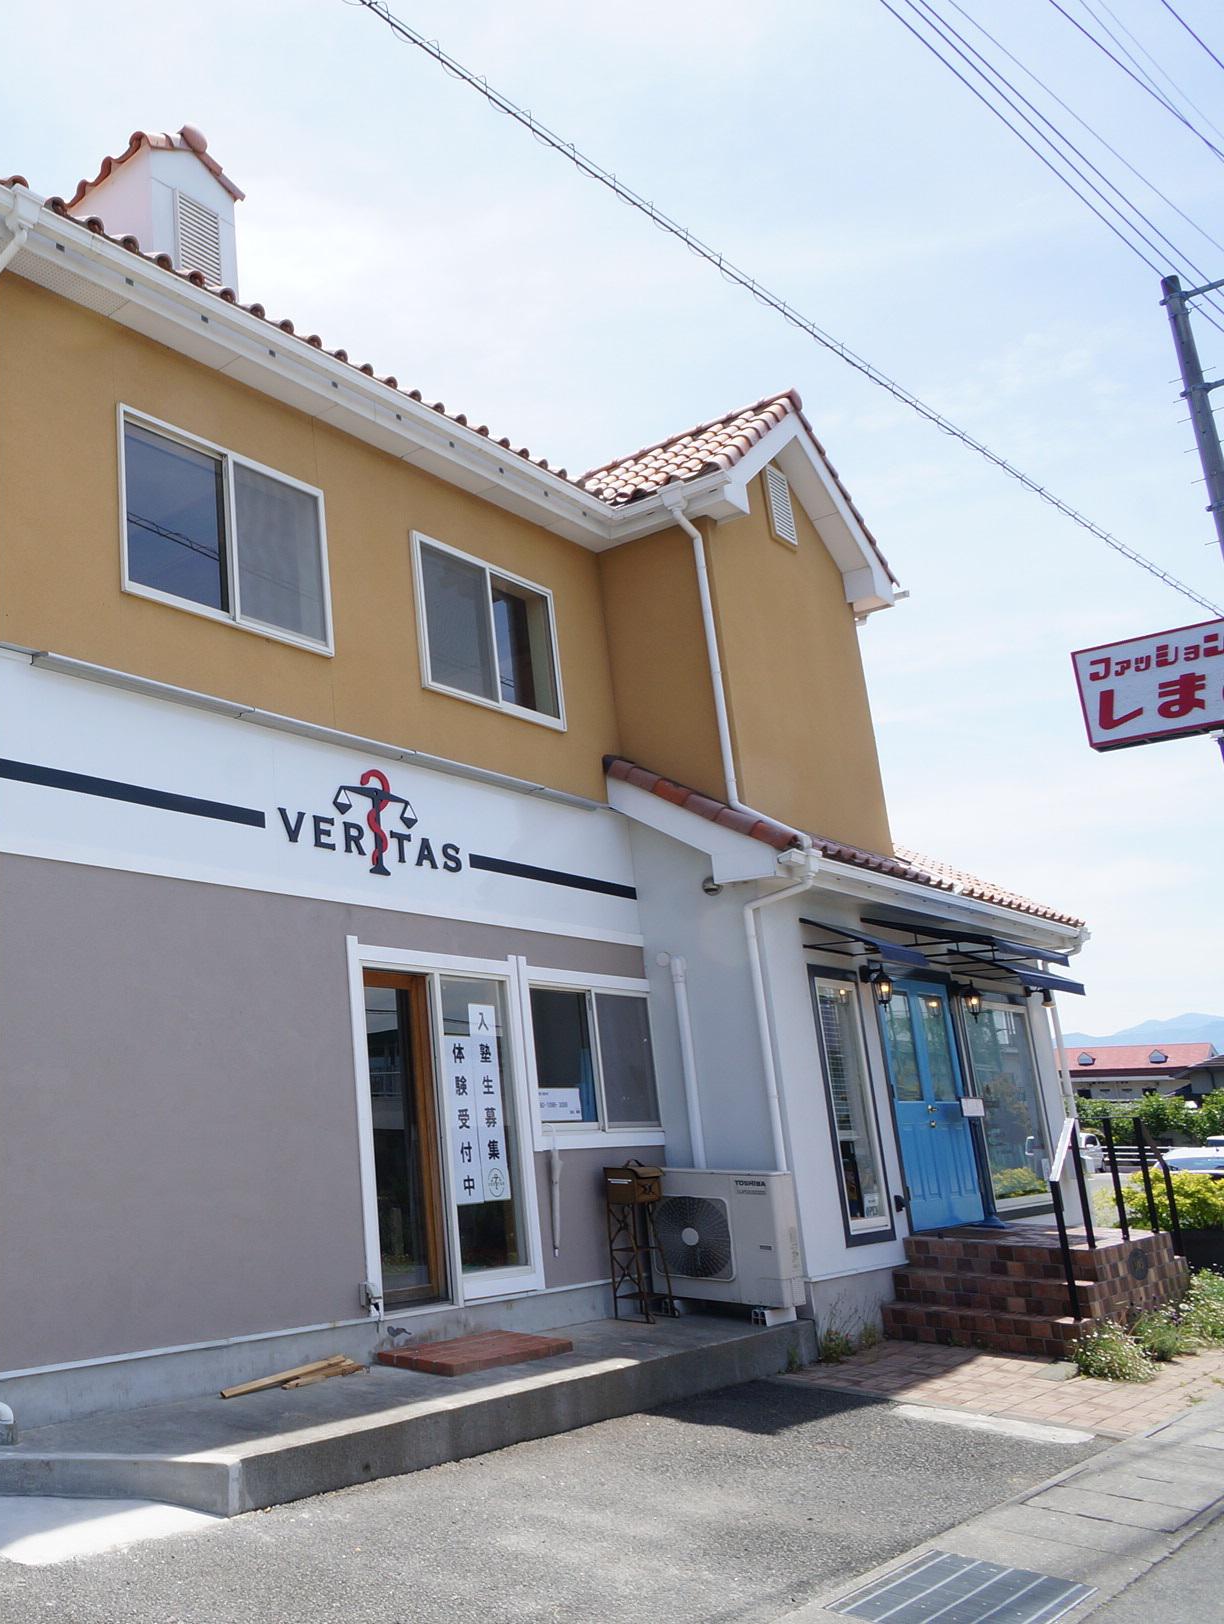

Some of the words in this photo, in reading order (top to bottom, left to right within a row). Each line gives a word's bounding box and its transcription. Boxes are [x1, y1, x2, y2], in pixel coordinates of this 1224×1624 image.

[1098, 672, 1224, 730] しま
[277, 785, 463, 876] VERITAS
[452, 1043, 475, 1196] 体験受付中
[478, 1012, 500, 1160] 入塾生募集
